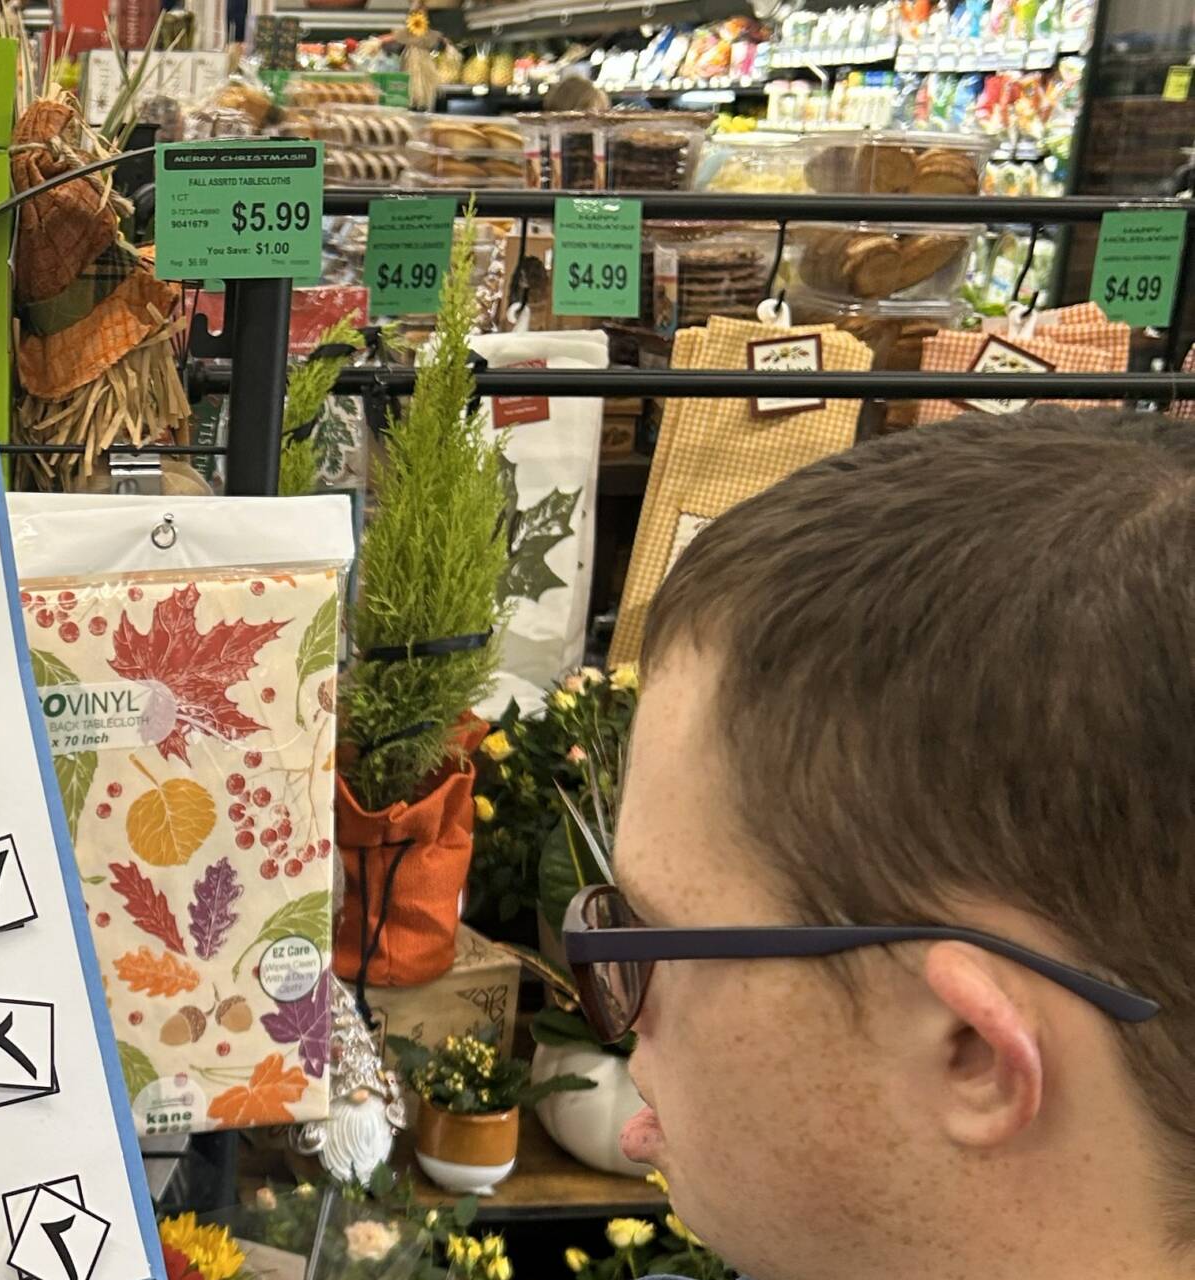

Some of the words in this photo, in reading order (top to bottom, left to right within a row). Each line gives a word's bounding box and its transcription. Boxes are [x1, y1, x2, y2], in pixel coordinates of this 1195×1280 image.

[173, 155, 216, 163] MERRY
[188, 178, 207, 187] FALL
[208, 177, 237, 187] ASSRTD
[238, 176, 291, 186] TABLECLOTHS
[231, 200, 311, 236] $5.99
[206, 246, 225, 255] You
[227, 246, 251, 254] Save:
[256, 242, 290, 255] $1.00
[376, 262, 437, 293] $4.99
[568, 261, 628, 291] $4.99
[1104, 274, 1162, 304] $4.99
[39, 690, 141, 718] OVINYL
[49, 721, 79, 732] BACK
[82, 716, 150, 730] TABLECLOTH
[64, 735, 79, 747] 70
[272, 946, 286, 959] EZ
[287, 945, 311, 957] Care
[146, 1111, 193, 1125] kane
